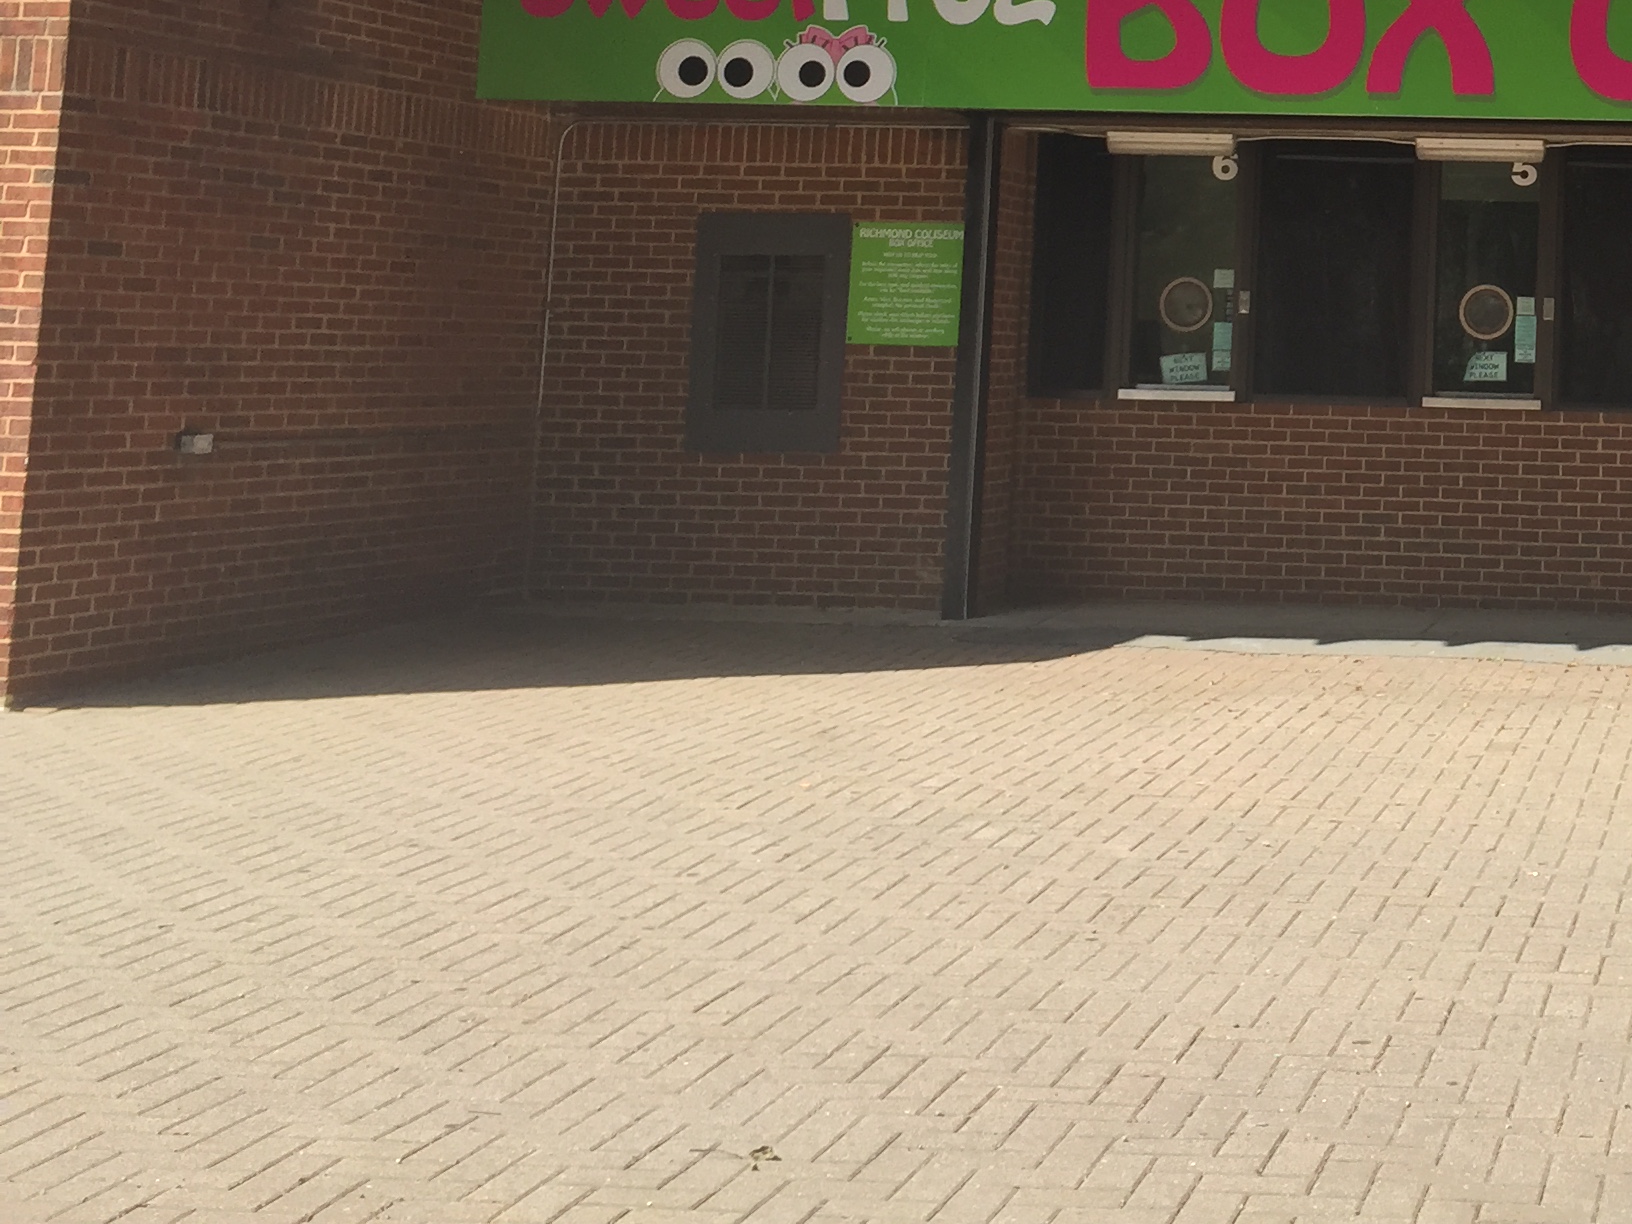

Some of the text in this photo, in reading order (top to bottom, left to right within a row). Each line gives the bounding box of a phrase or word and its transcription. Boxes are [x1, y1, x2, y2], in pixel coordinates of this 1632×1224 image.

[1213, 155, 1238, 181] 6
[1511, 162, 1537, 186] 5
[860, 228, 965, 240] RICHMOND COLISEUM
